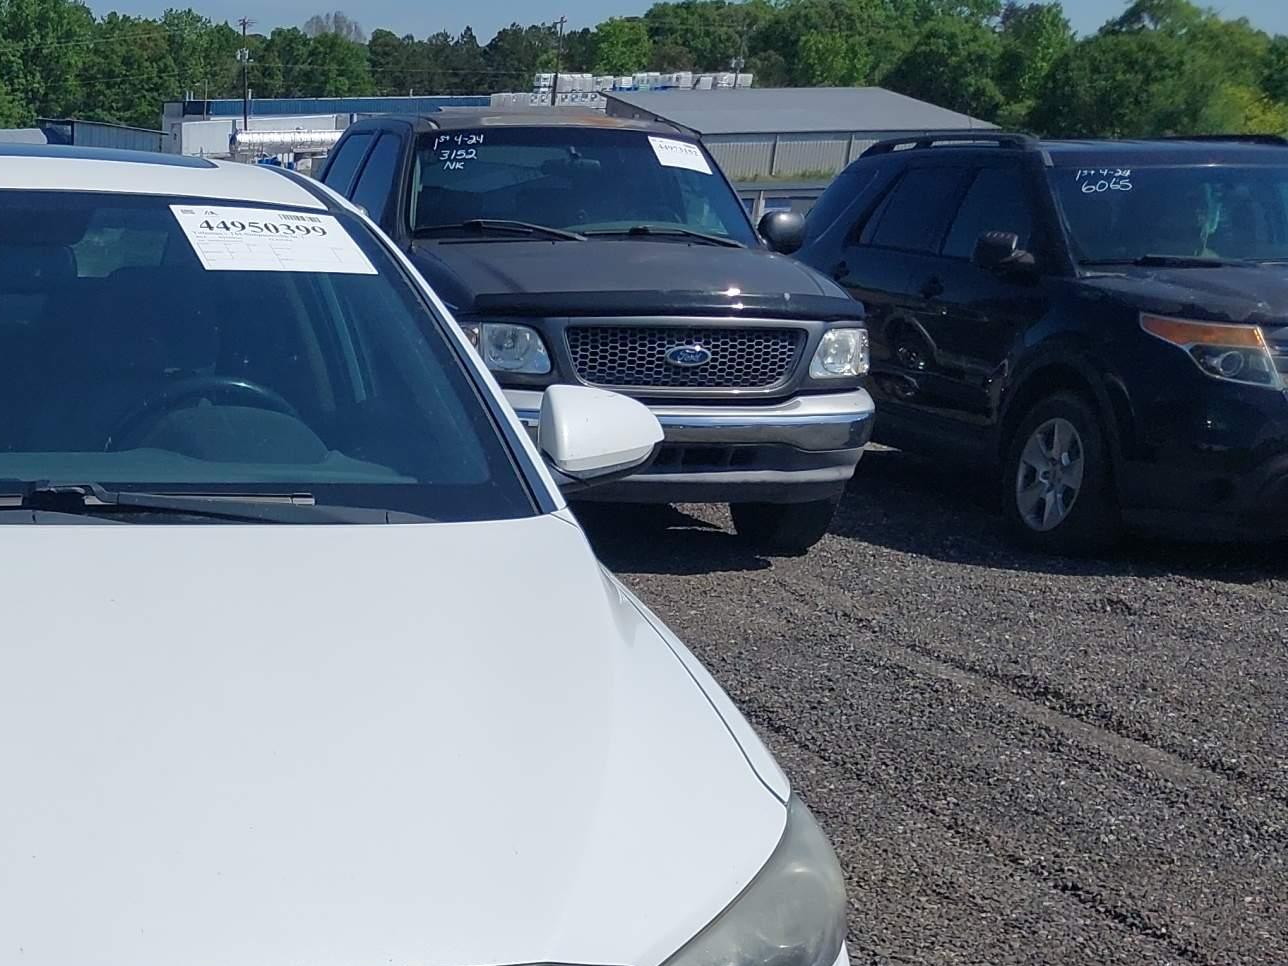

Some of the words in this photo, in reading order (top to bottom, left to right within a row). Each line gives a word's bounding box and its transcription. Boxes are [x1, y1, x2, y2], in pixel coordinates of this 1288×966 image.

[454, 134, 484, 145] 4-24
[439, 148, 477, 160] 3152
[443, 161, 465, 170] NK
[1099, 168, 1131, 177] 4-24
[1081, 178, 1133, 193] 6065
[199, 219, 328, 237] 44950399
